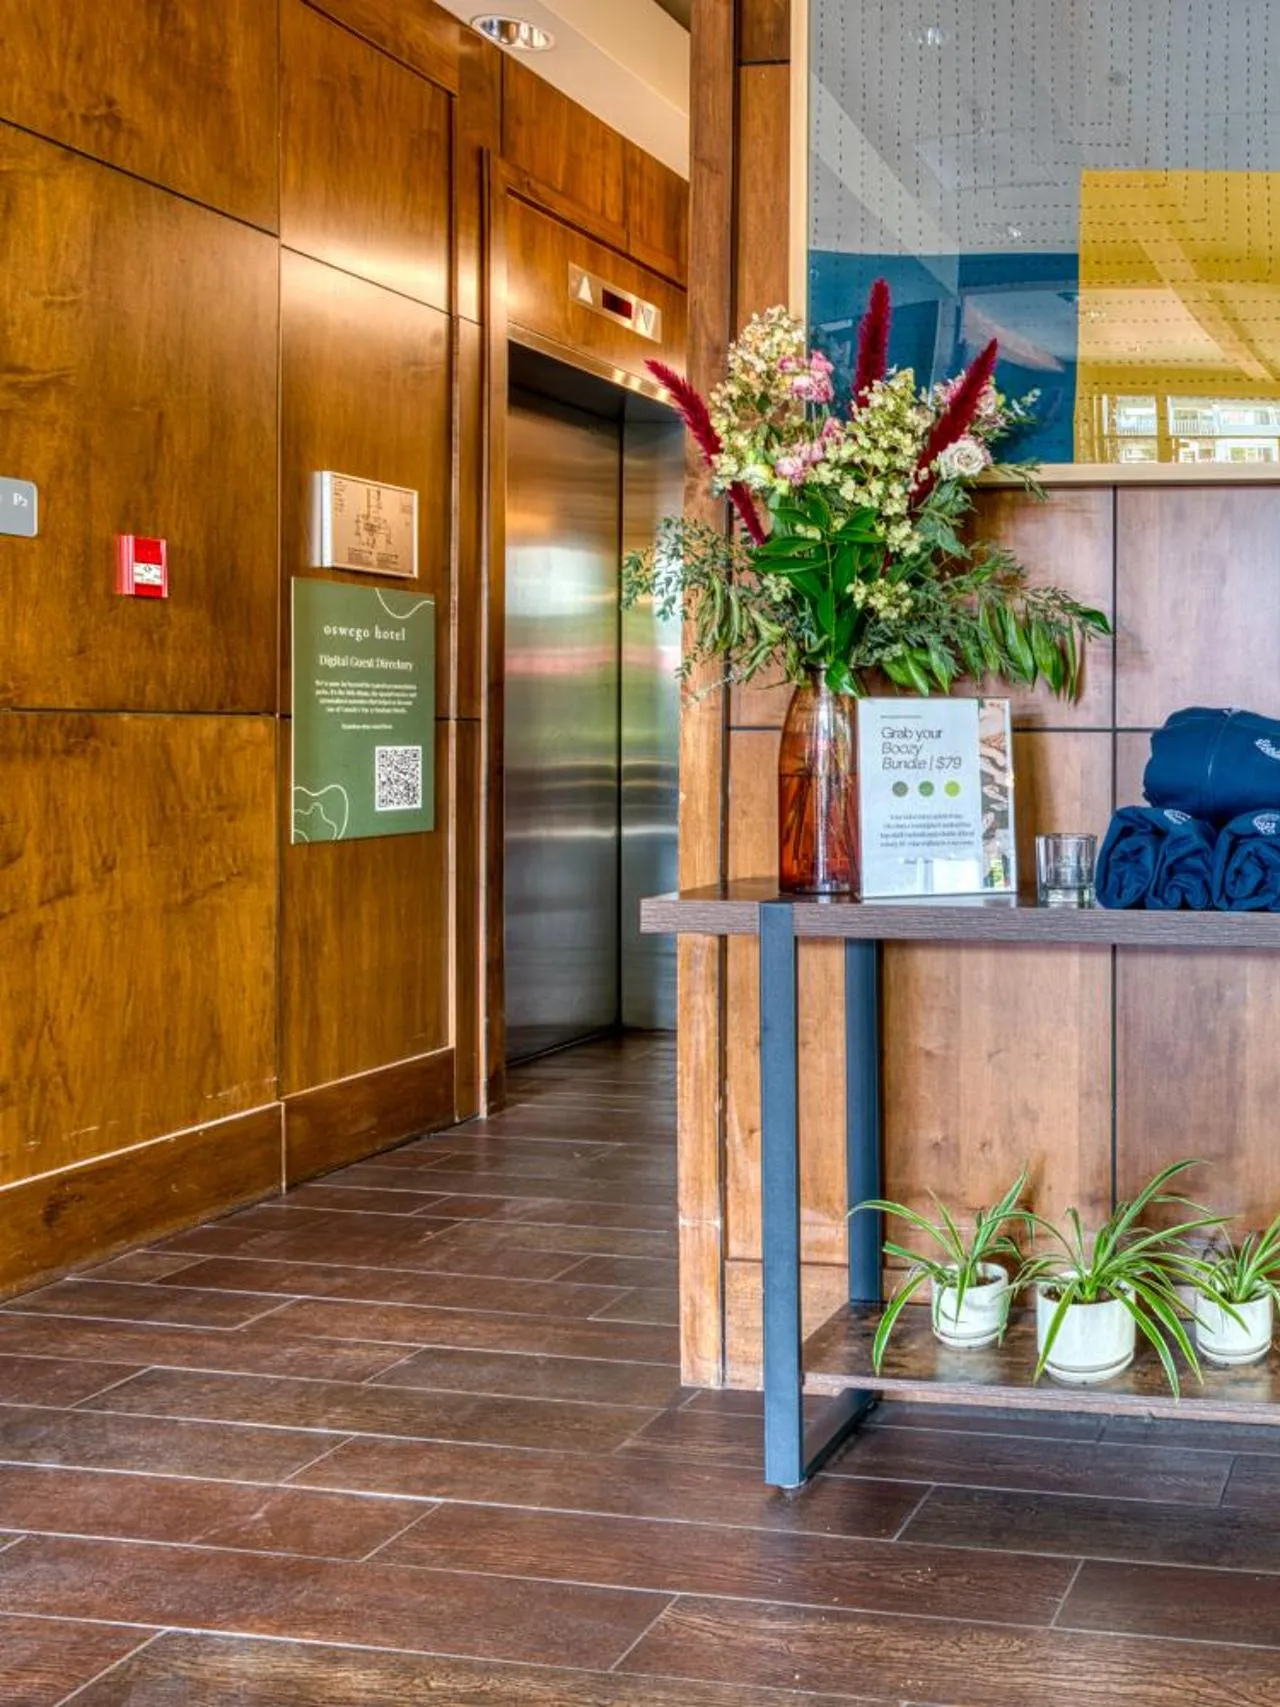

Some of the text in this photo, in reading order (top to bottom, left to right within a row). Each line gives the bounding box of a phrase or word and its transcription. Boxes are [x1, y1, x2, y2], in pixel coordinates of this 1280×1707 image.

[323, 623, 406, 642] oswego hotel
[319, 654, 349, 669] Digital
[350, 656, 375, 669] Guest
[881, 726, 943, 742] Grab your
[882, 741, 923, 756] Boozy
[882, 756, 928, 770] Bundle
[935, 755, 962, 770] $79
